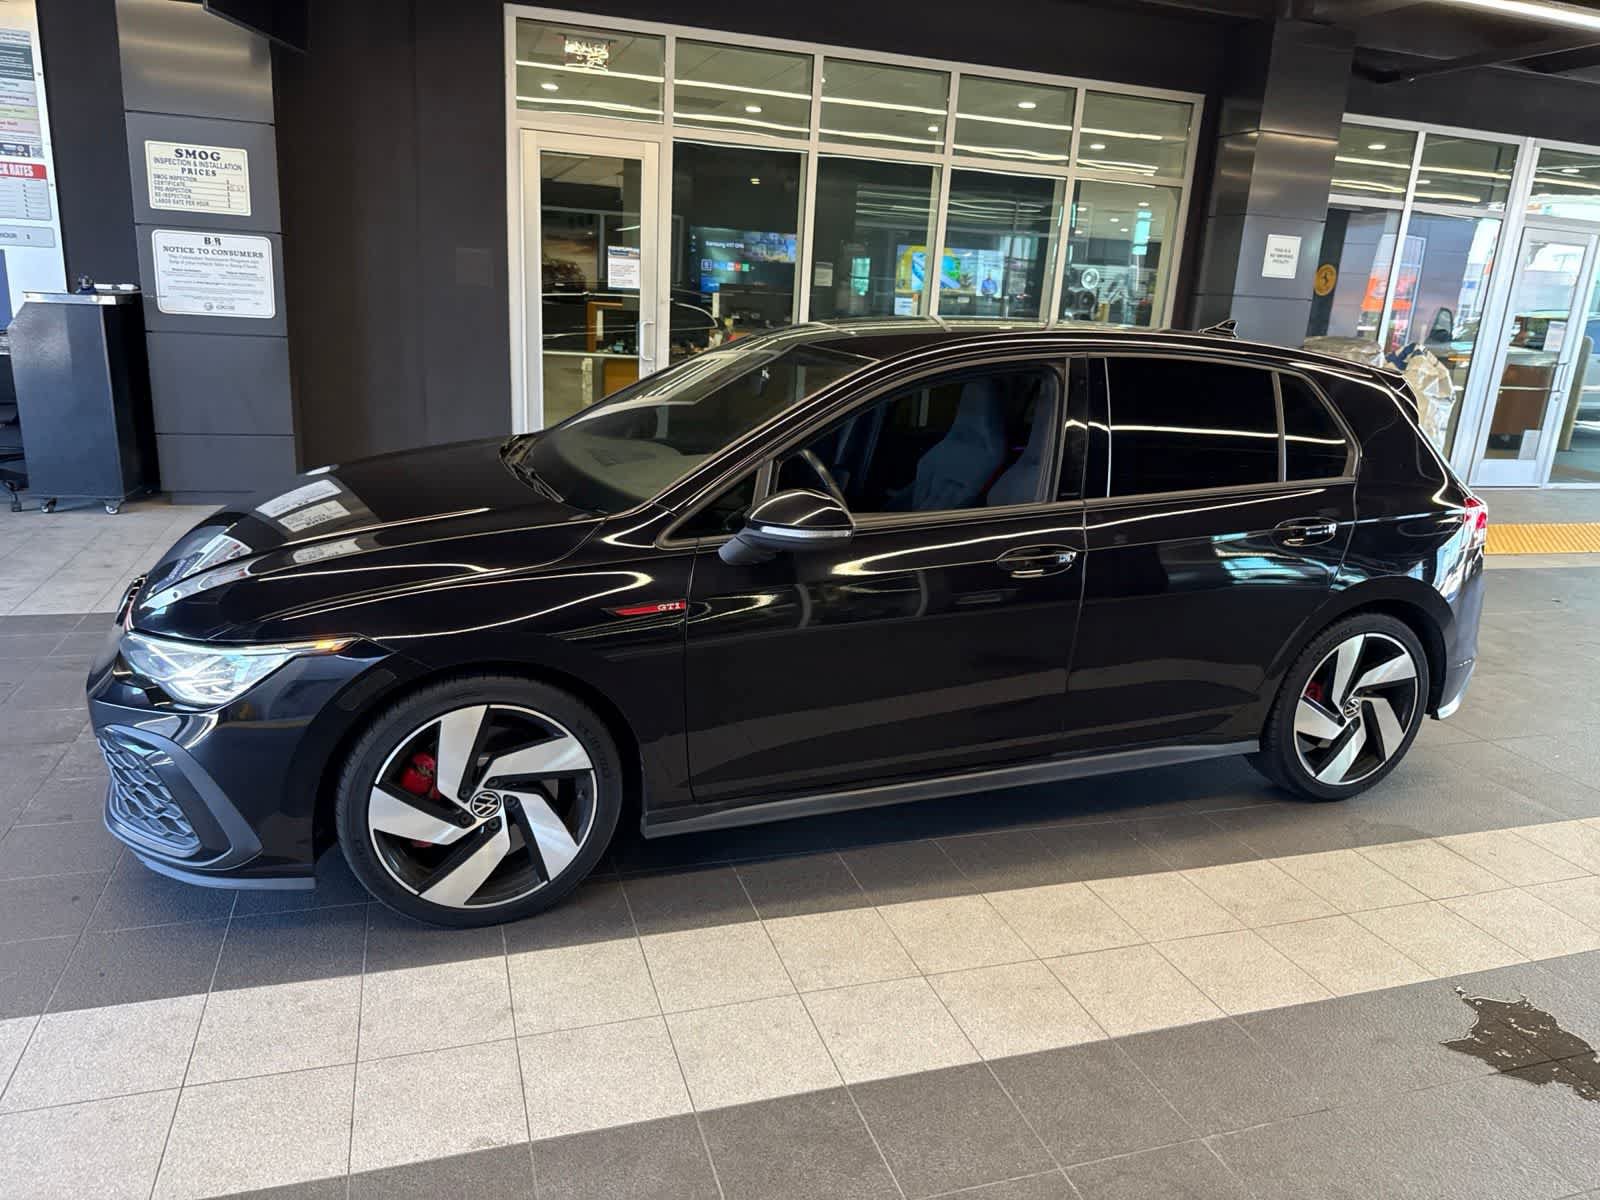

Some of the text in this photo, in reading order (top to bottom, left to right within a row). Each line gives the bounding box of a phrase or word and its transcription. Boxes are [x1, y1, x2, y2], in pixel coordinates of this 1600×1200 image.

[174, 148, 221, 161] SMOG
[153, 157, 192, 167] INSPECTION
[199, 160, 242, 171] INSTALLATION
[181, 167, 217, 177] PRICES
[163, 246, 264, 258] NOTICE TO CONSUMERS
[657, 602, 680, 611] GTI
